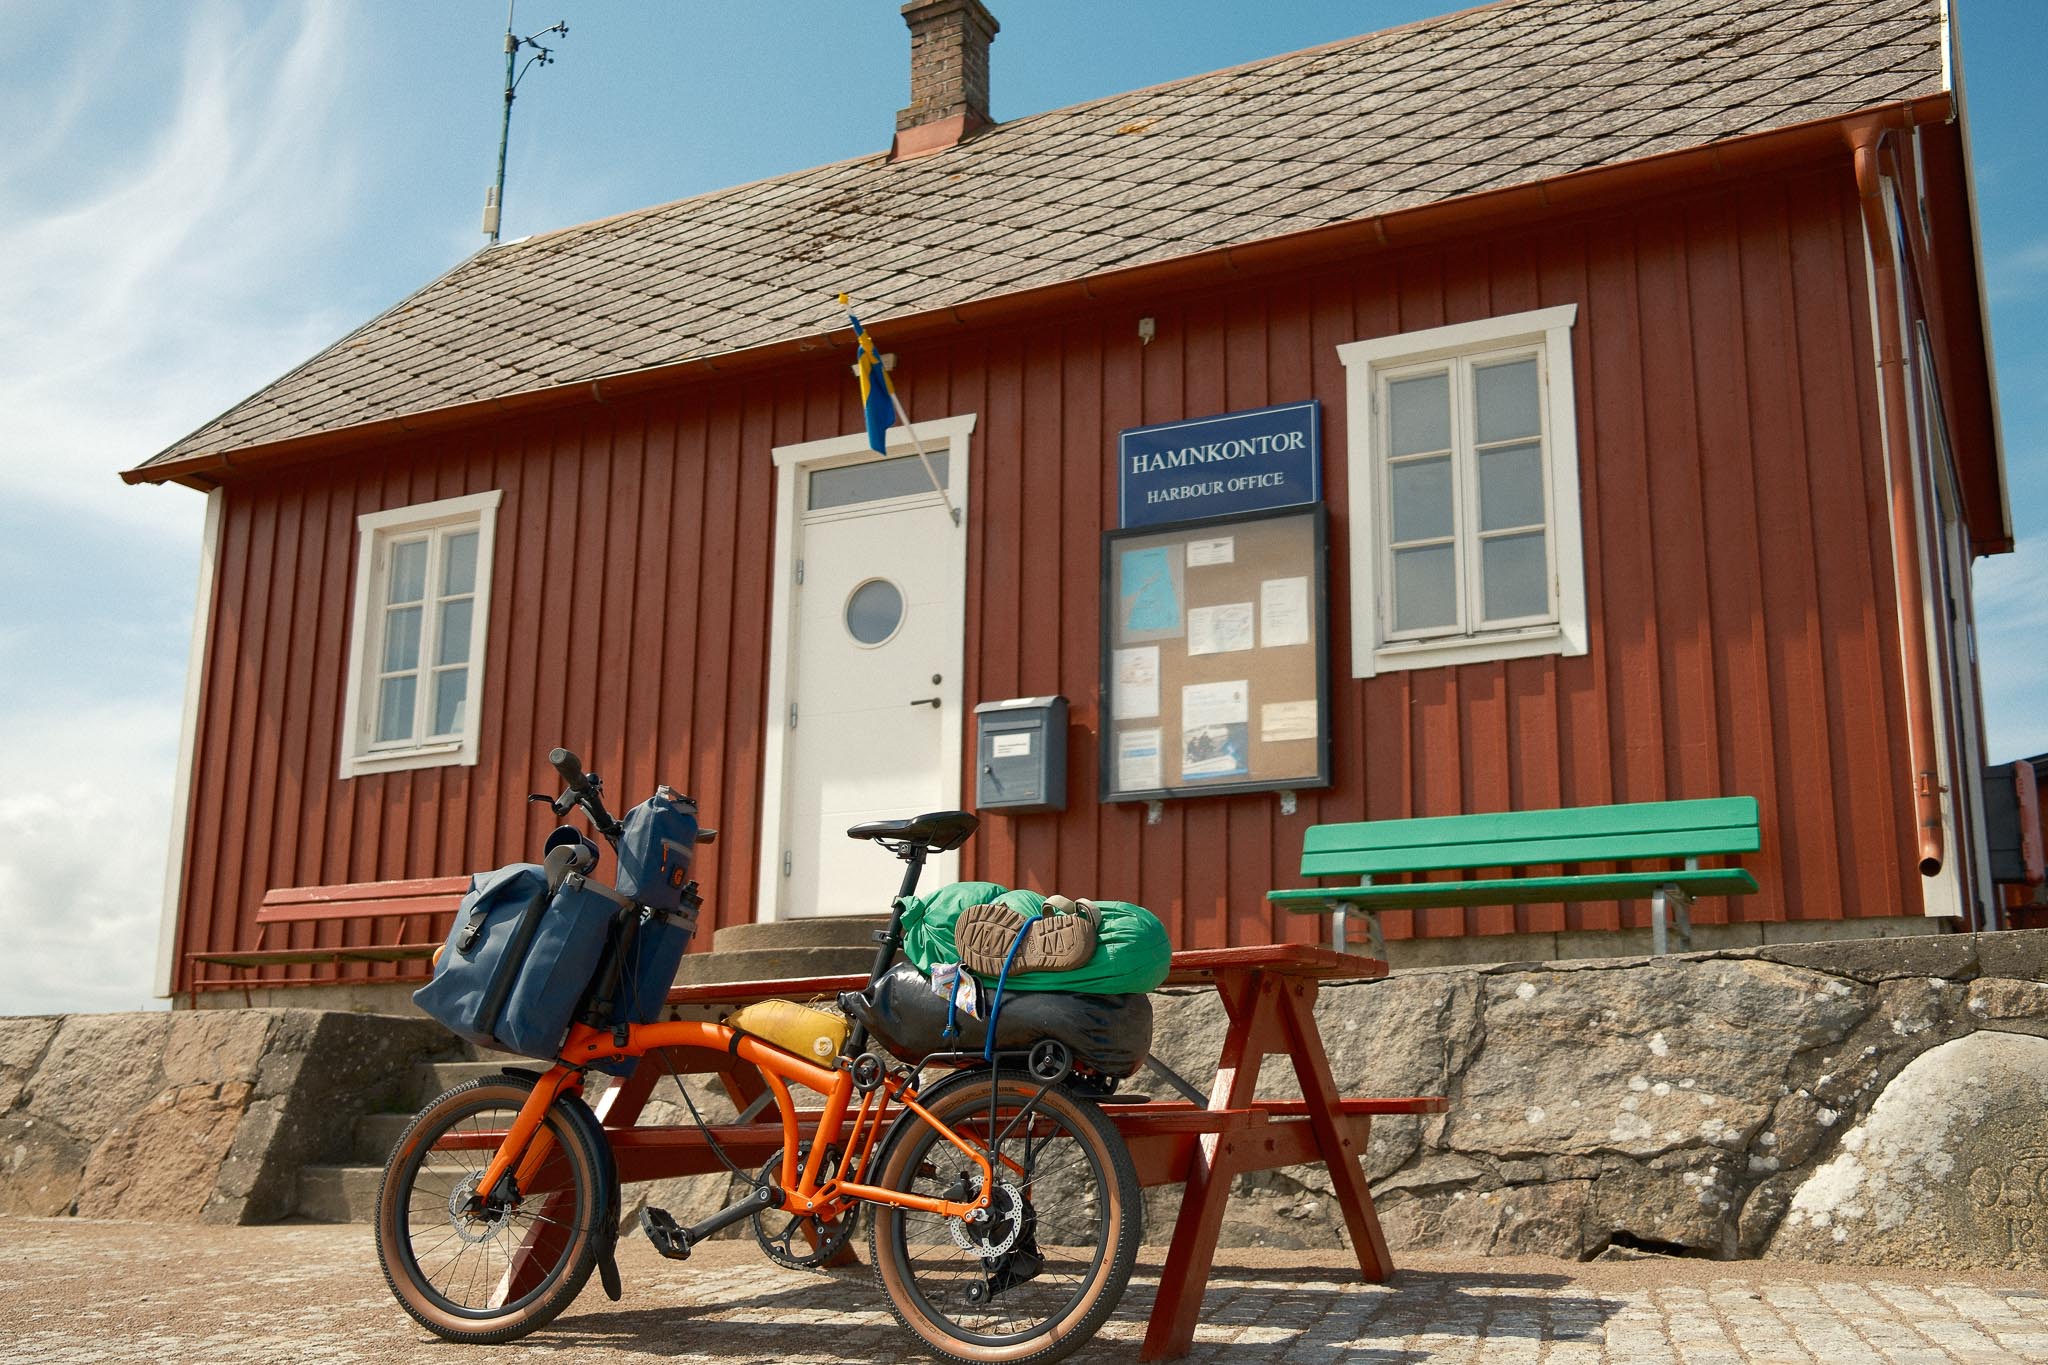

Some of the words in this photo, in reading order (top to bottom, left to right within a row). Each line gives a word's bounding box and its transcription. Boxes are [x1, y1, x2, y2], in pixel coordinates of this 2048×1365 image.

[1131, 431, 1306, 474] HAMNKONTOR
[1147, 480, 1224, 504] HARBOUR
[1227, 472, 1284, 492] OFFICE
